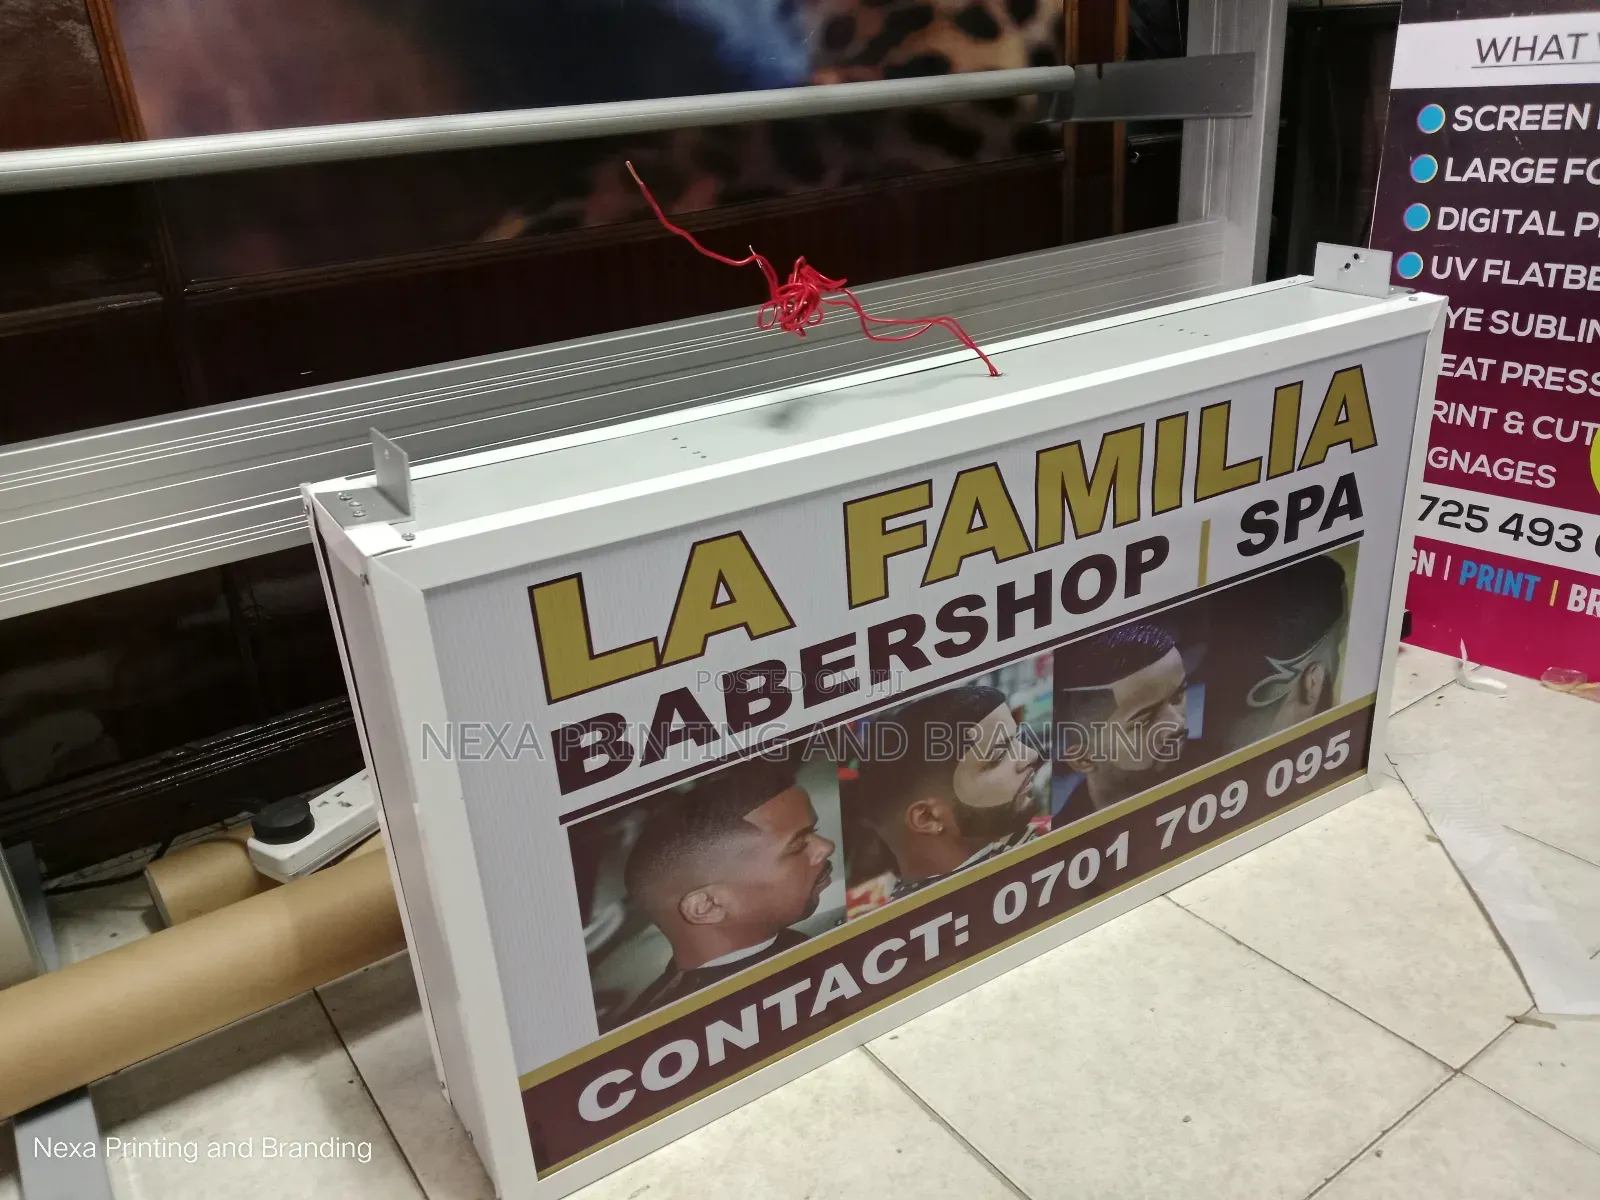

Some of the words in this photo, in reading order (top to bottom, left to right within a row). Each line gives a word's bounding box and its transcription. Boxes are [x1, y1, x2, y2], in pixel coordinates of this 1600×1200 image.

[1476, 33, 1589, 63] WHAT
[1452, 103, 1591, 131] SCREEN
[1444, 157, 1558, 184] LARGE
[1437, 207, 1565, 237] DIGITAL
[1431, 256, 1478, 281] UV
[1503, 411, 1525, 435] &
[1533, 416, 1600, 446] CUT
[528, 531, 796, 705] LA
[843, 364, 1378, 610] FAMILIA
[1498, 513, 1583, 553] 493
[1459, 560, 1541, 602] PRINT
[551, 535, 1170, 796] BABERSHOP
[1236, 472, 1363, 557] SPA
[578, 911, 969, 1122] CONTACT:
[992, 830, 1130, 925] 0701
[1156, 780, 1248, 849] 709
[1265, 729, 1351, 797] 095
